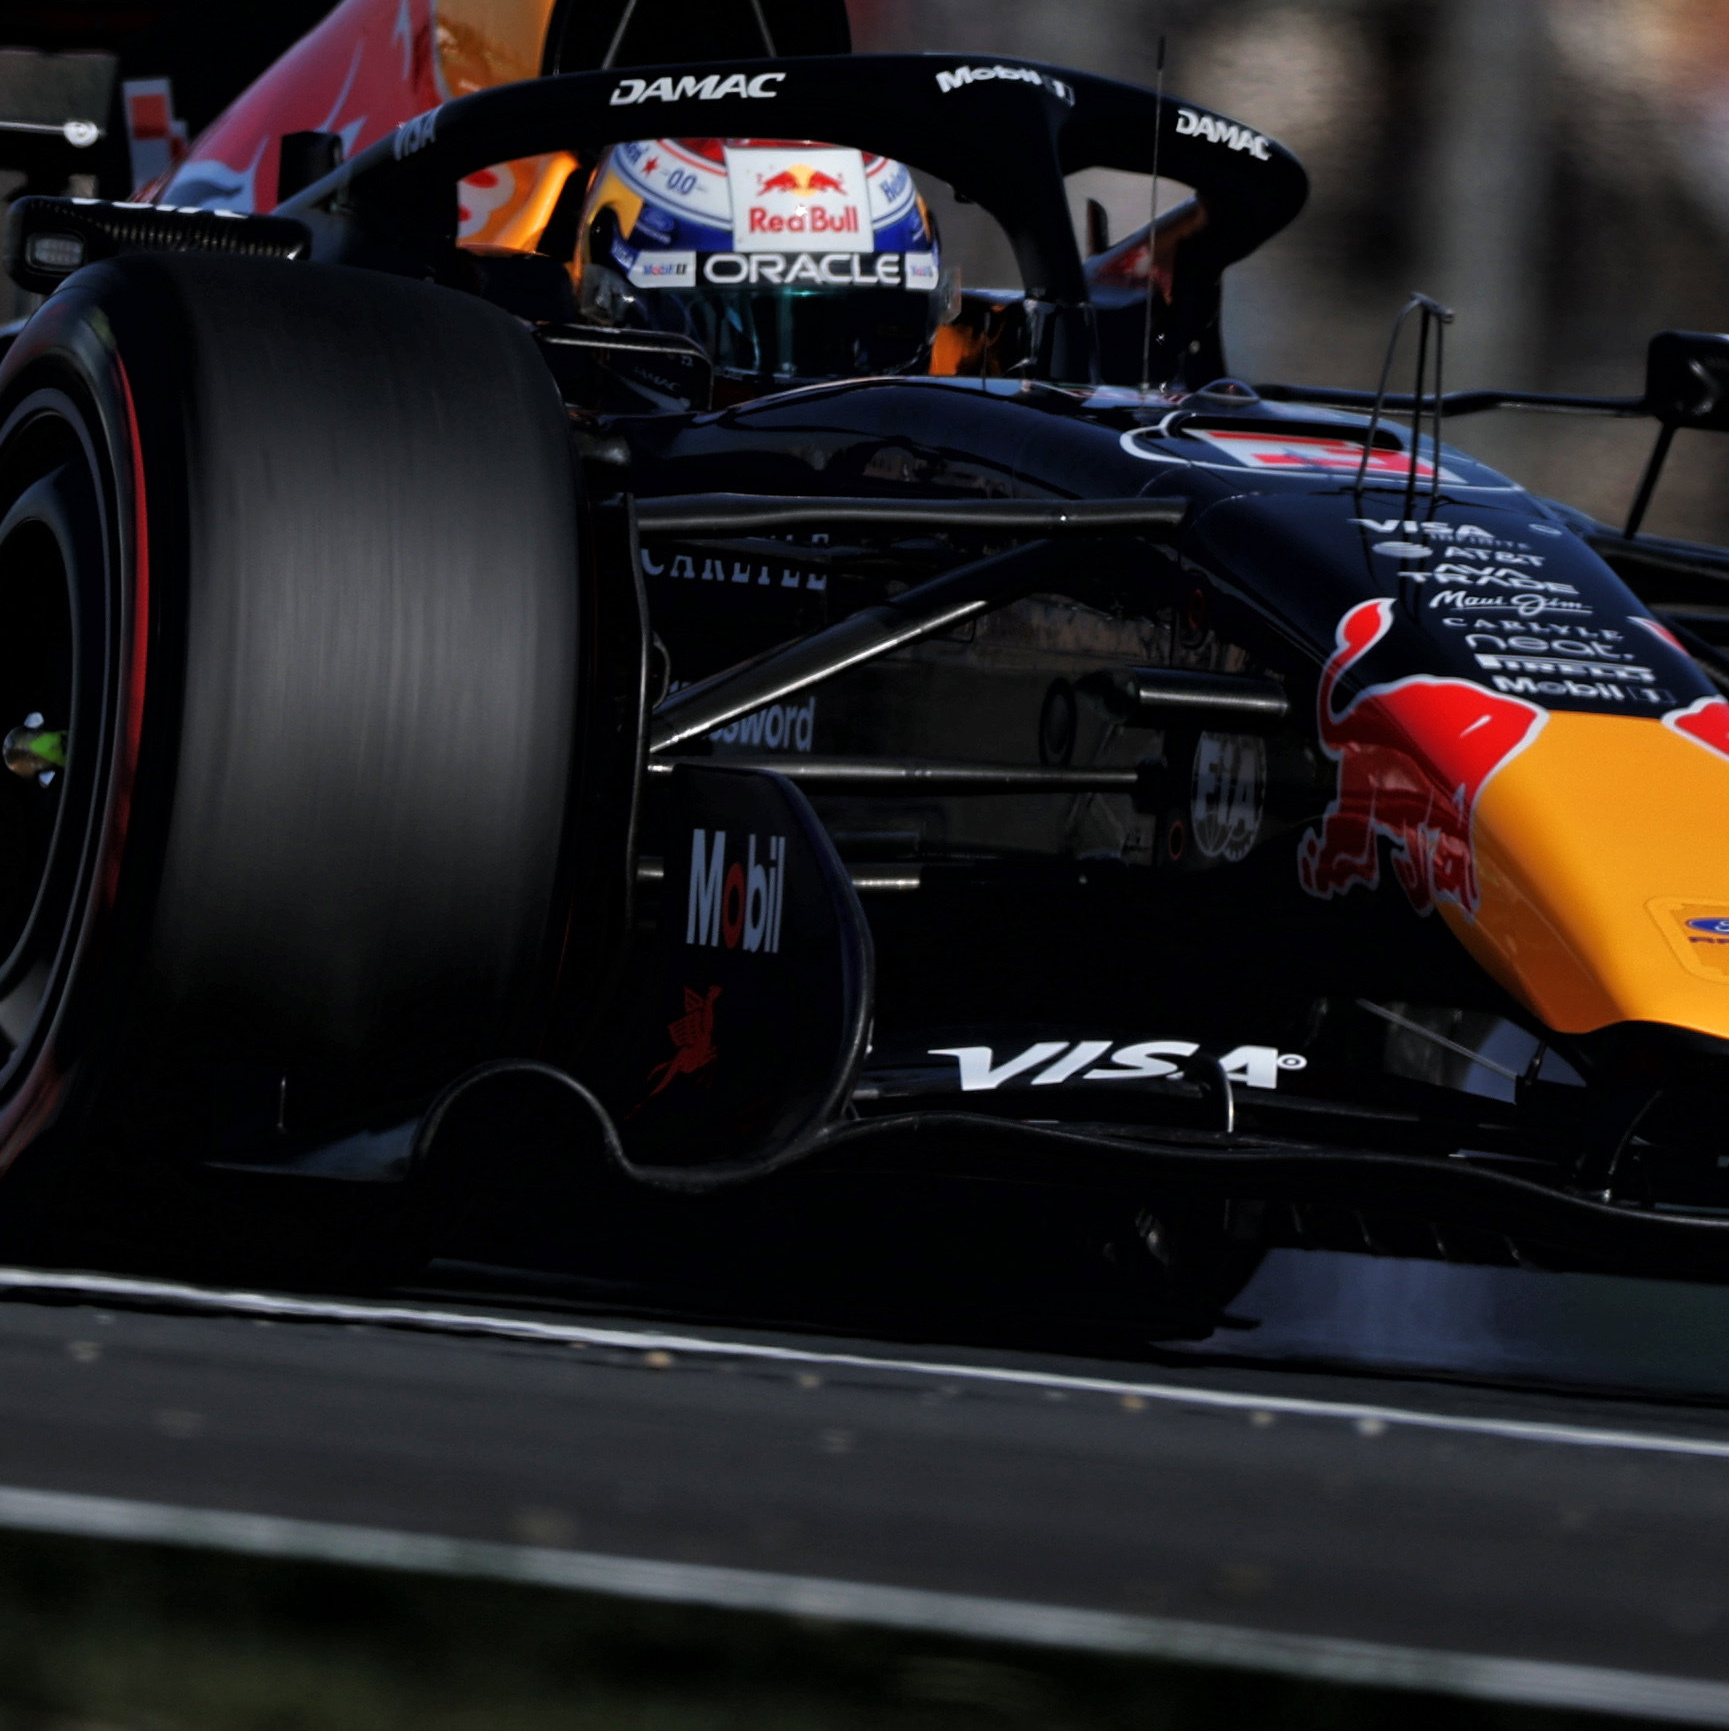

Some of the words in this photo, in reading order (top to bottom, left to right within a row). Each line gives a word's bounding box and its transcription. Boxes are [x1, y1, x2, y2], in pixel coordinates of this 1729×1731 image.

[607, 71, 789, 107] DAMAC
[935, 64, 1042, 94] Mobil
[1174, 107, 1274, 162] DAMAC
[749, 204, 806, 233] Red
[810, 205, 859, 233] Bull
[703, 252, 902, 285] ORACLE
[1348, 518, 1496, 540] VISA
[1444, 545, 1546, 568] AT&T
[1428, 589, 1508, 610] Maui
[1441, 616, 1625, 643] CARLYLE
[1464, 633, 1636, 661] neat.
[1474, 652, 1657, 683] PIRELLI
[1491, 674, 1625, 702] Mobil
[685, 828, 786, 954] Mobil
[927, 1040, 1279, 1092] VISA
